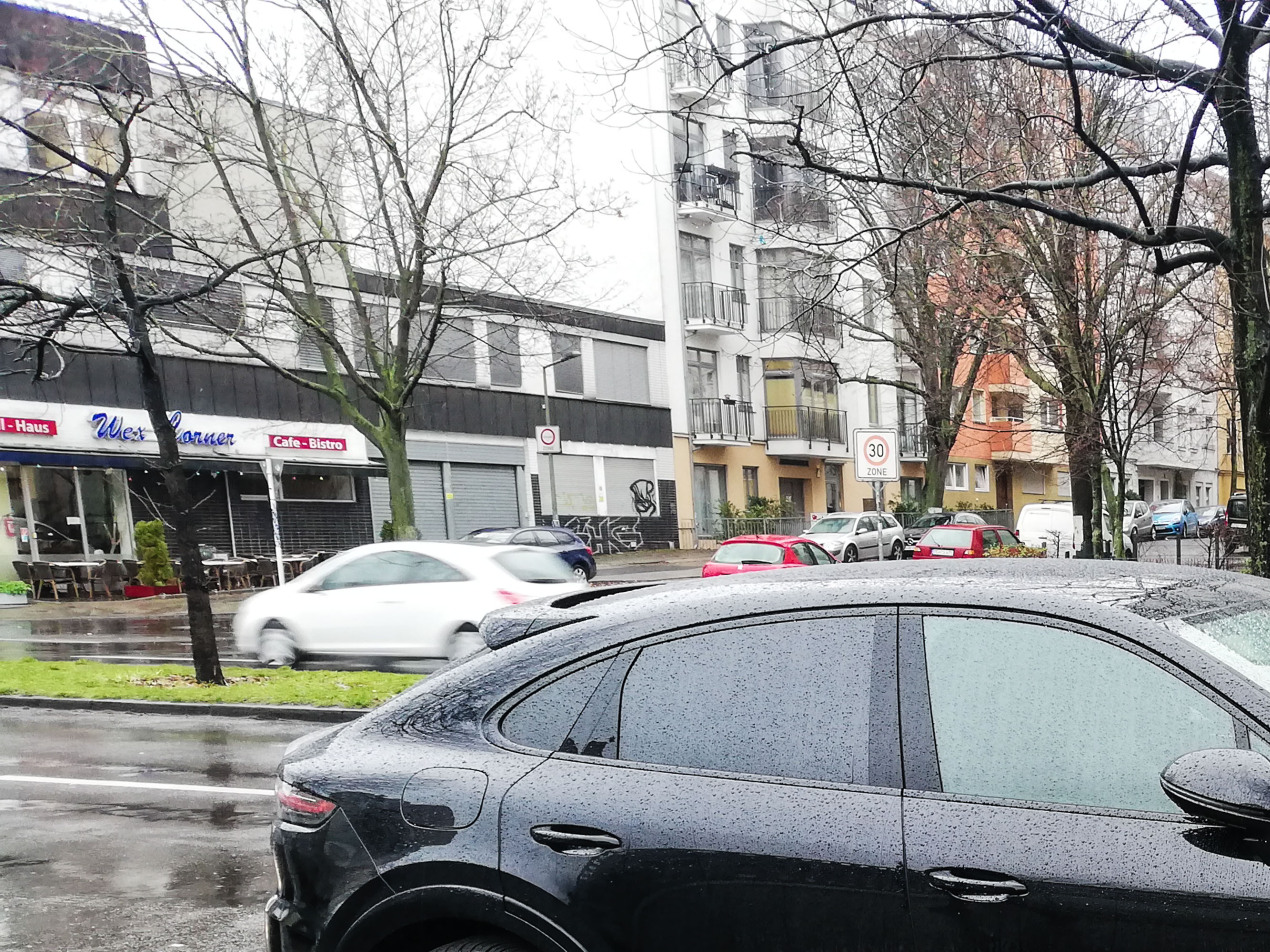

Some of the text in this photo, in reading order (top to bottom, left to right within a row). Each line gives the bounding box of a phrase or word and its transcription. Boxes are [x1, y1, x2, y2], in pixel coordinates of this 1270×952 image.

[15, 419, 50, 433] Haus
[92, 412, 146, 441] Wex
[868, 443, 884, 458] 30
[867, 467, 887, 476] ZONE
